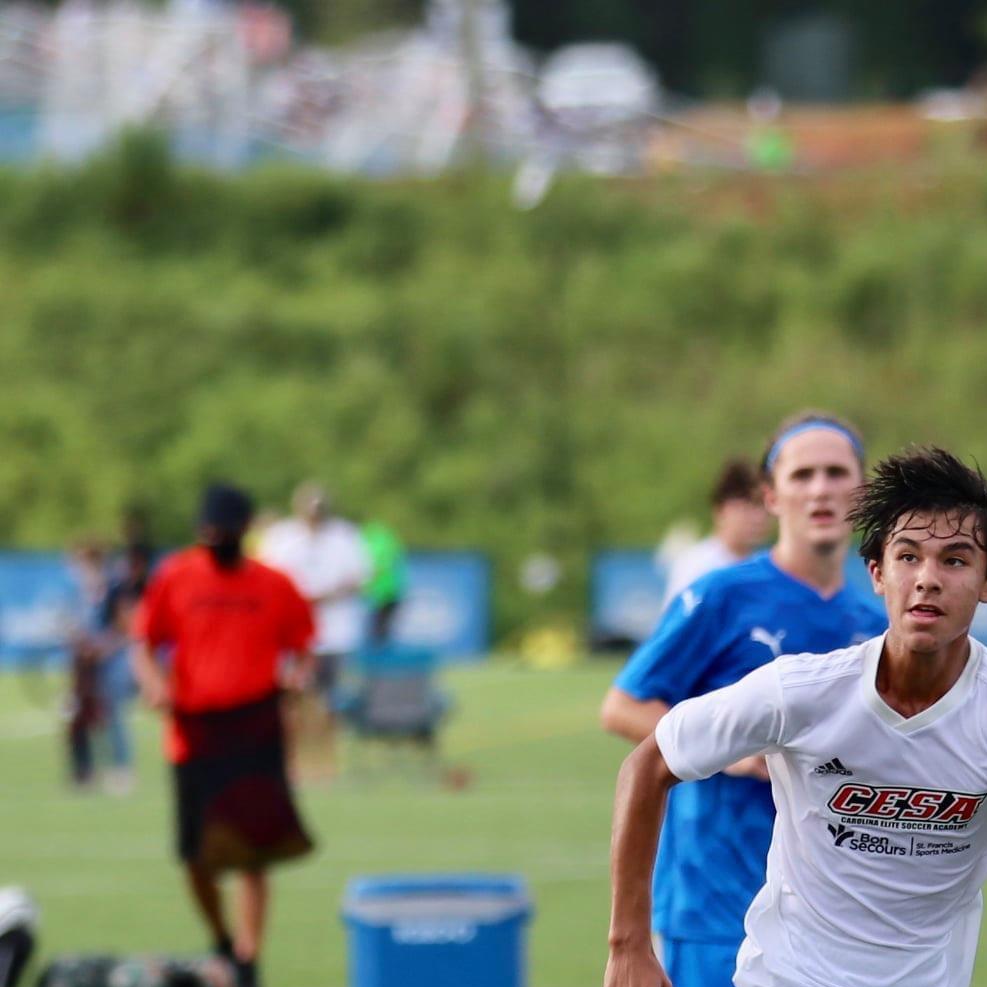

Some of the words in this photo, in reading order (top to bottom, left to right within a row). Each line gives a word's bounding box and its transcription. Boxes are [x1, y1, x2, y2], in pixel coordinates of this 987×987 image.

[828, 783, 987, 822] CESA
[841, 816, 878, 827] CAROLINA
[880, 820, 899, 829] ELITE
[901, 822, 932, 830] SOCCER
[860, 833, 889, 845] Bon
[927, 841, 954, 849] Francis
[850, 838, 906, 856] Secours
[915, 849, 939, 857] Sports
